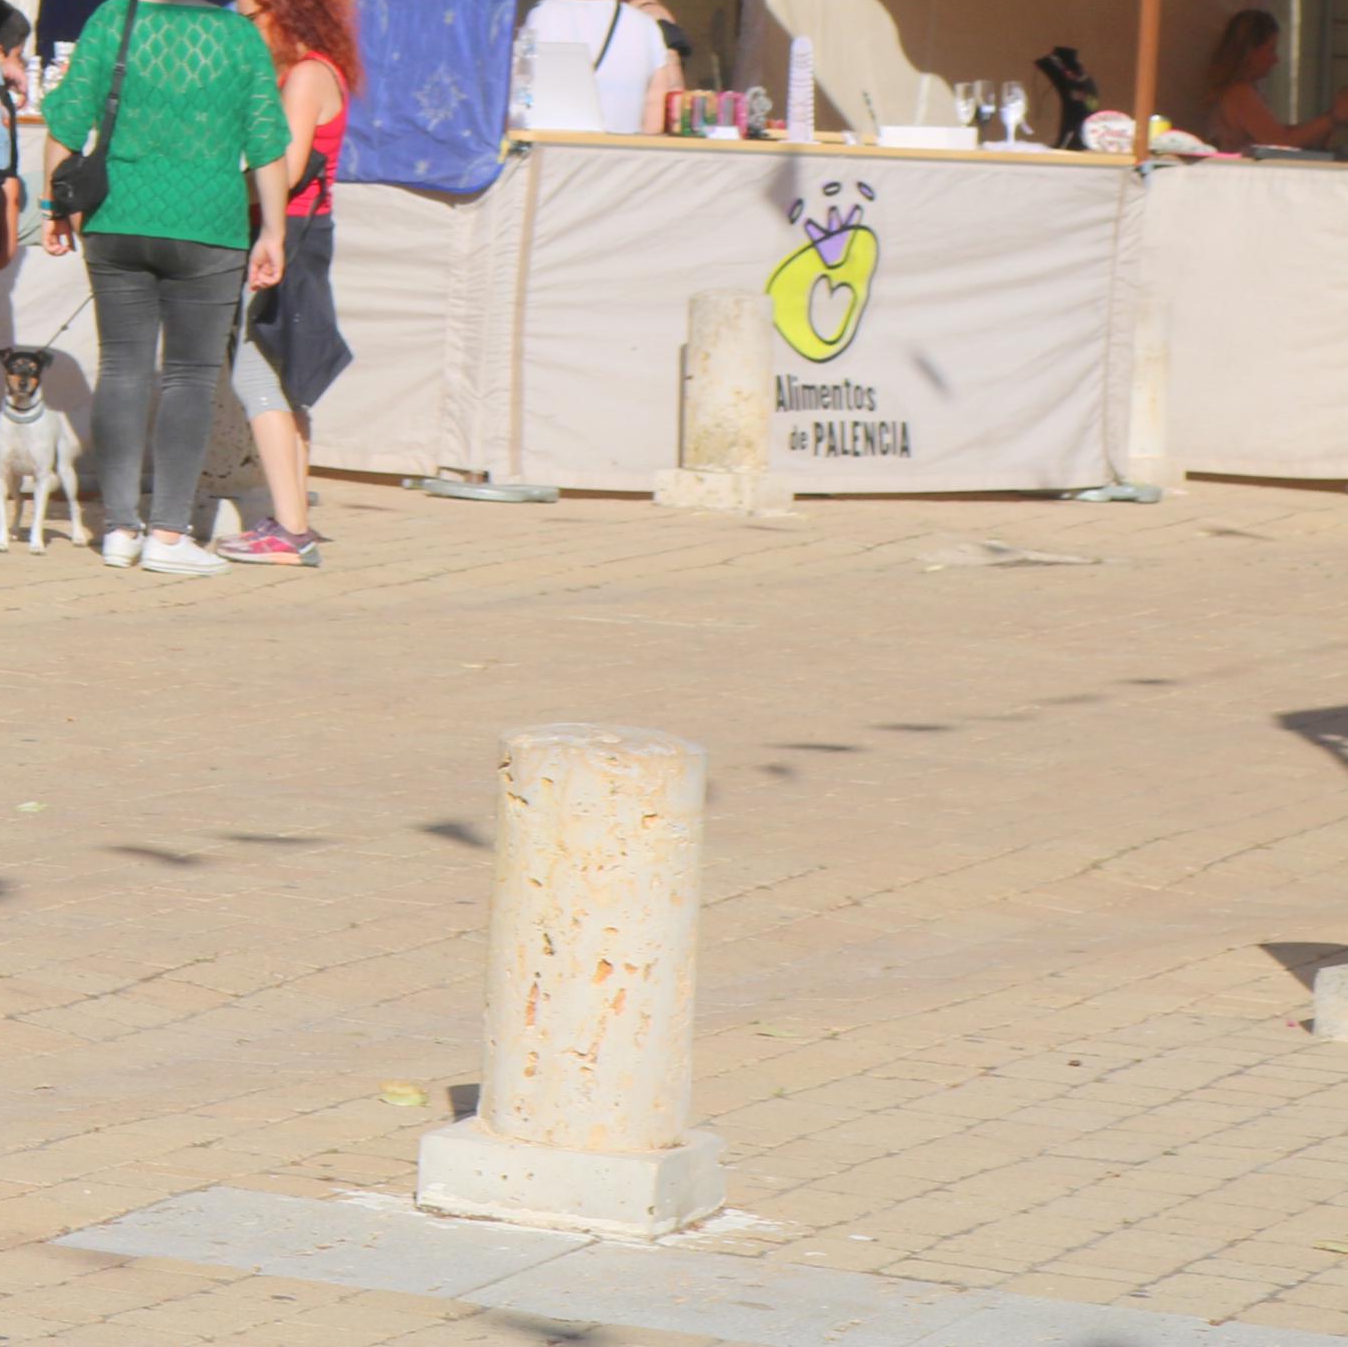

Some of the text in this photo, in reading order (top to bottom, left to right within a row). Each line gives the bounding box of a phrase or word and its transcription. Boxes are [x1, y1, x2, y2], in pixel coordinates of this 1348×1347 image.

[775, 374, 877, 412] Alimentos
[789, 420, 913, 458] de PALENCIA
